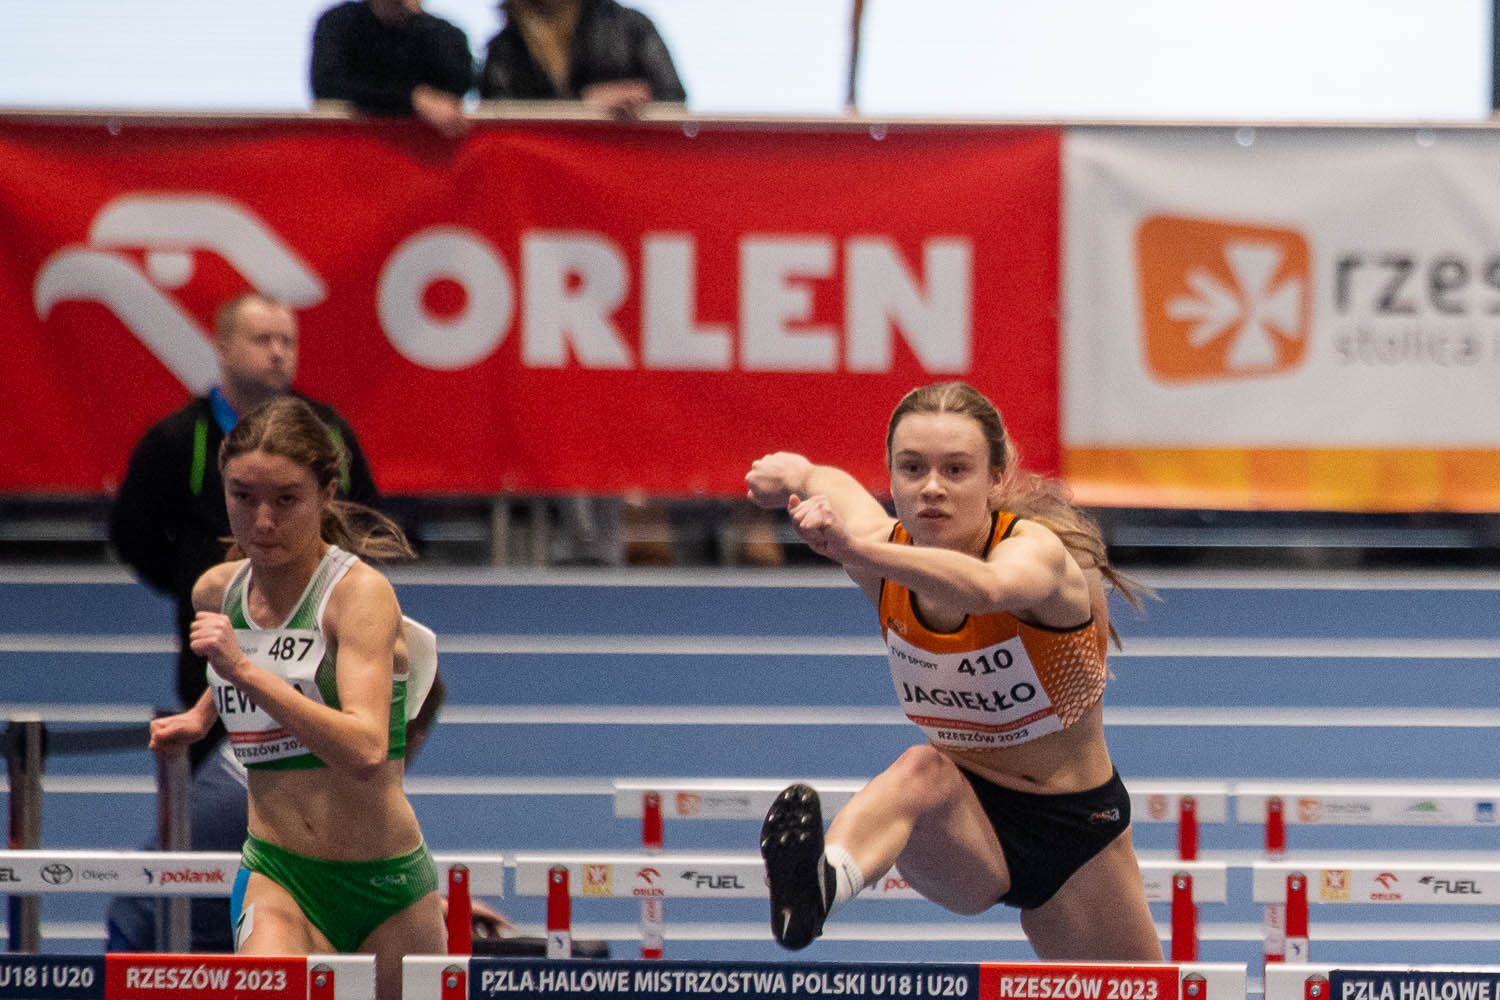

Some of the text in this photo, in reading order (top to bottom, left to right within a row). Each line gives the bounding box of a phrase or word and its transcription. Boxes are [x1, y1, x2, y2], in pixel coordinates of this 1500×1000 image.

[377, 225, 972, 372] ORLEN
[269, 636, 314, 661] 487
[957, 648, 1014, 676] 410
[903, 681, 1036, 713] JAGIEŁŁO
[938, 729, 1029, 743] RZESZÓW 2023
[159, 868, 225, 885] polanik
[696, 875, 745, 889] FUEL
[1433, 880, 1482, 895] FUEL
[0, 965, 287, 991] U18 i U20 RZESZÓW 2023
[481, 970, 1158, 1000] PZLA HALOWE MISTRZOSTWA POLSKI U18 i U20 RZESZÓW 2023
